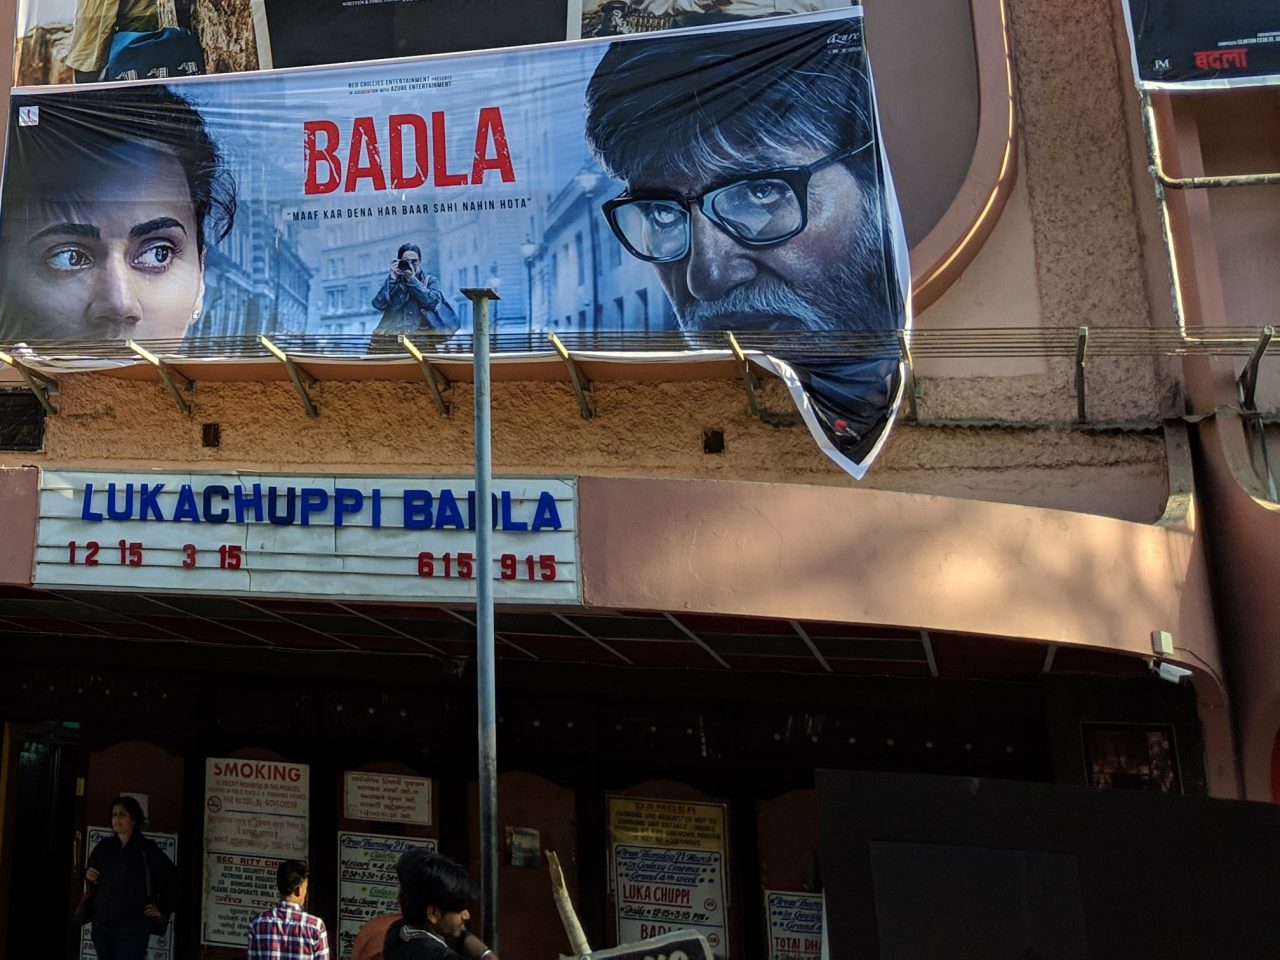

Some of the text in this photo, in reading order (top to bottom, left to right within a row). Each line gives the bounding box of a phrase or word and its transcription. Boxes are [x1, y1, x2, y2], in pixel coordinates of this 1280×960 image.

[1194, 48, 1248, 70] बदला
[385, 76, 430, 85] ENTERTAINMENT
[409, 81, 452, 90] ENTERTAINMENT
[303, 106, 515, 195] BADLA
[323, 208, 342, 219] KAR
[347, 207, 372, 218] DENA
[378, 206, 397, 216] HAR
[402, 204, 428, 215] BAAR
[433, 203, 457, 213] SAHI
[463, 201, 494, 211] NAHIN
[119, 540, 143, 567] 15
[182, 544, 196, 569] 3
[219, 545, 242, 570] 15
[214, 763, 301, 782] SMOKING
[217, 856, 260, 865] SECRITY
[623, 884, 690, 905] LUKA CHUPPI
[775, 937, 800, 949] TOTAL
